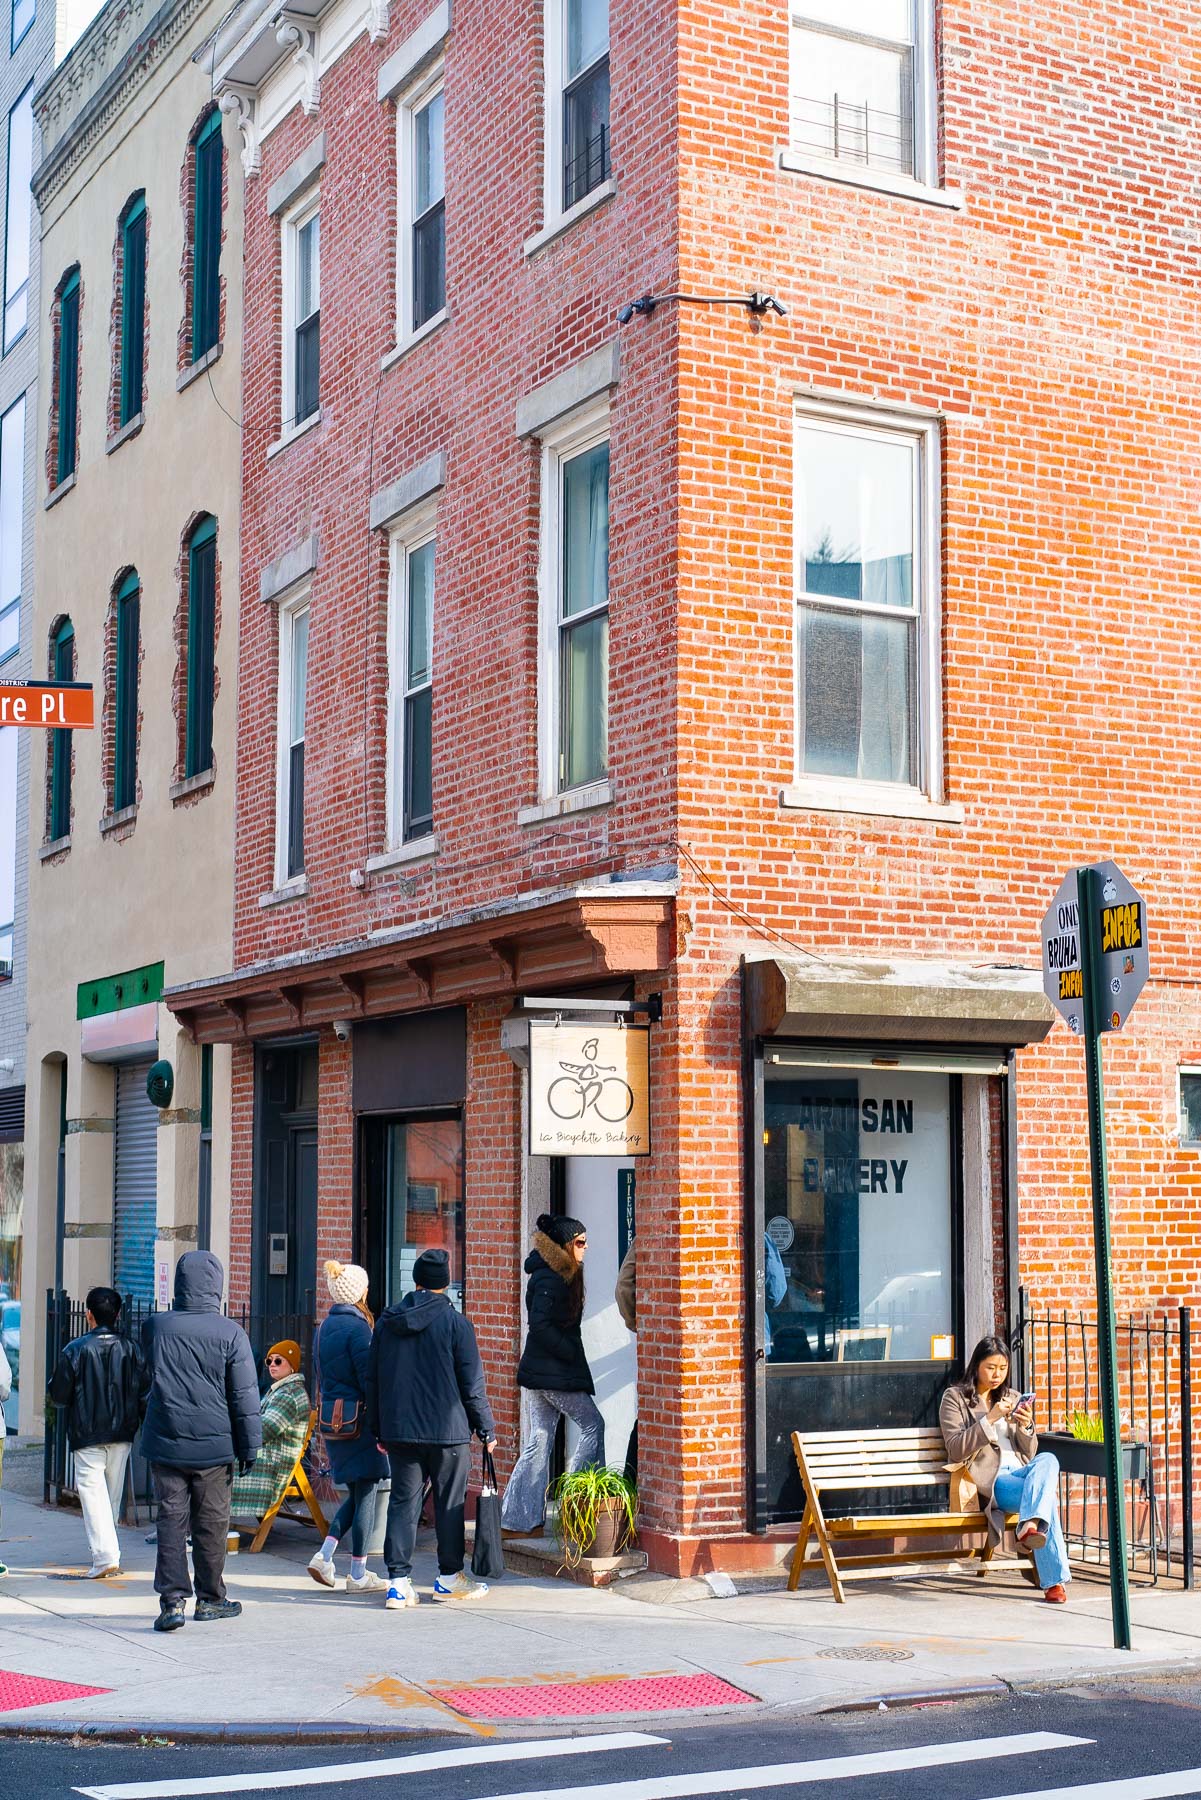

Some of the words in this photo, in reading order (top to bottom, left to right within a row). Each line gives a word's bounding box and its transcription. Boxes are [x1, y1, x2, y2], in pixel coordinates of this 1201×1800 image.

[1, 697, 27, 721] re
[41, 692, 66, 723] Pl
[1047, 935, 1078, 968] BRUHA
[799, 1098, 913, 1133] ARTISAN
[539, 1132, 553, 1142] La
[556, 1130, 602, 1146] Bicyclette
[606, 1131, 641, 1146] Bakery
[803, 1158, 909, 1193] BAKERY
